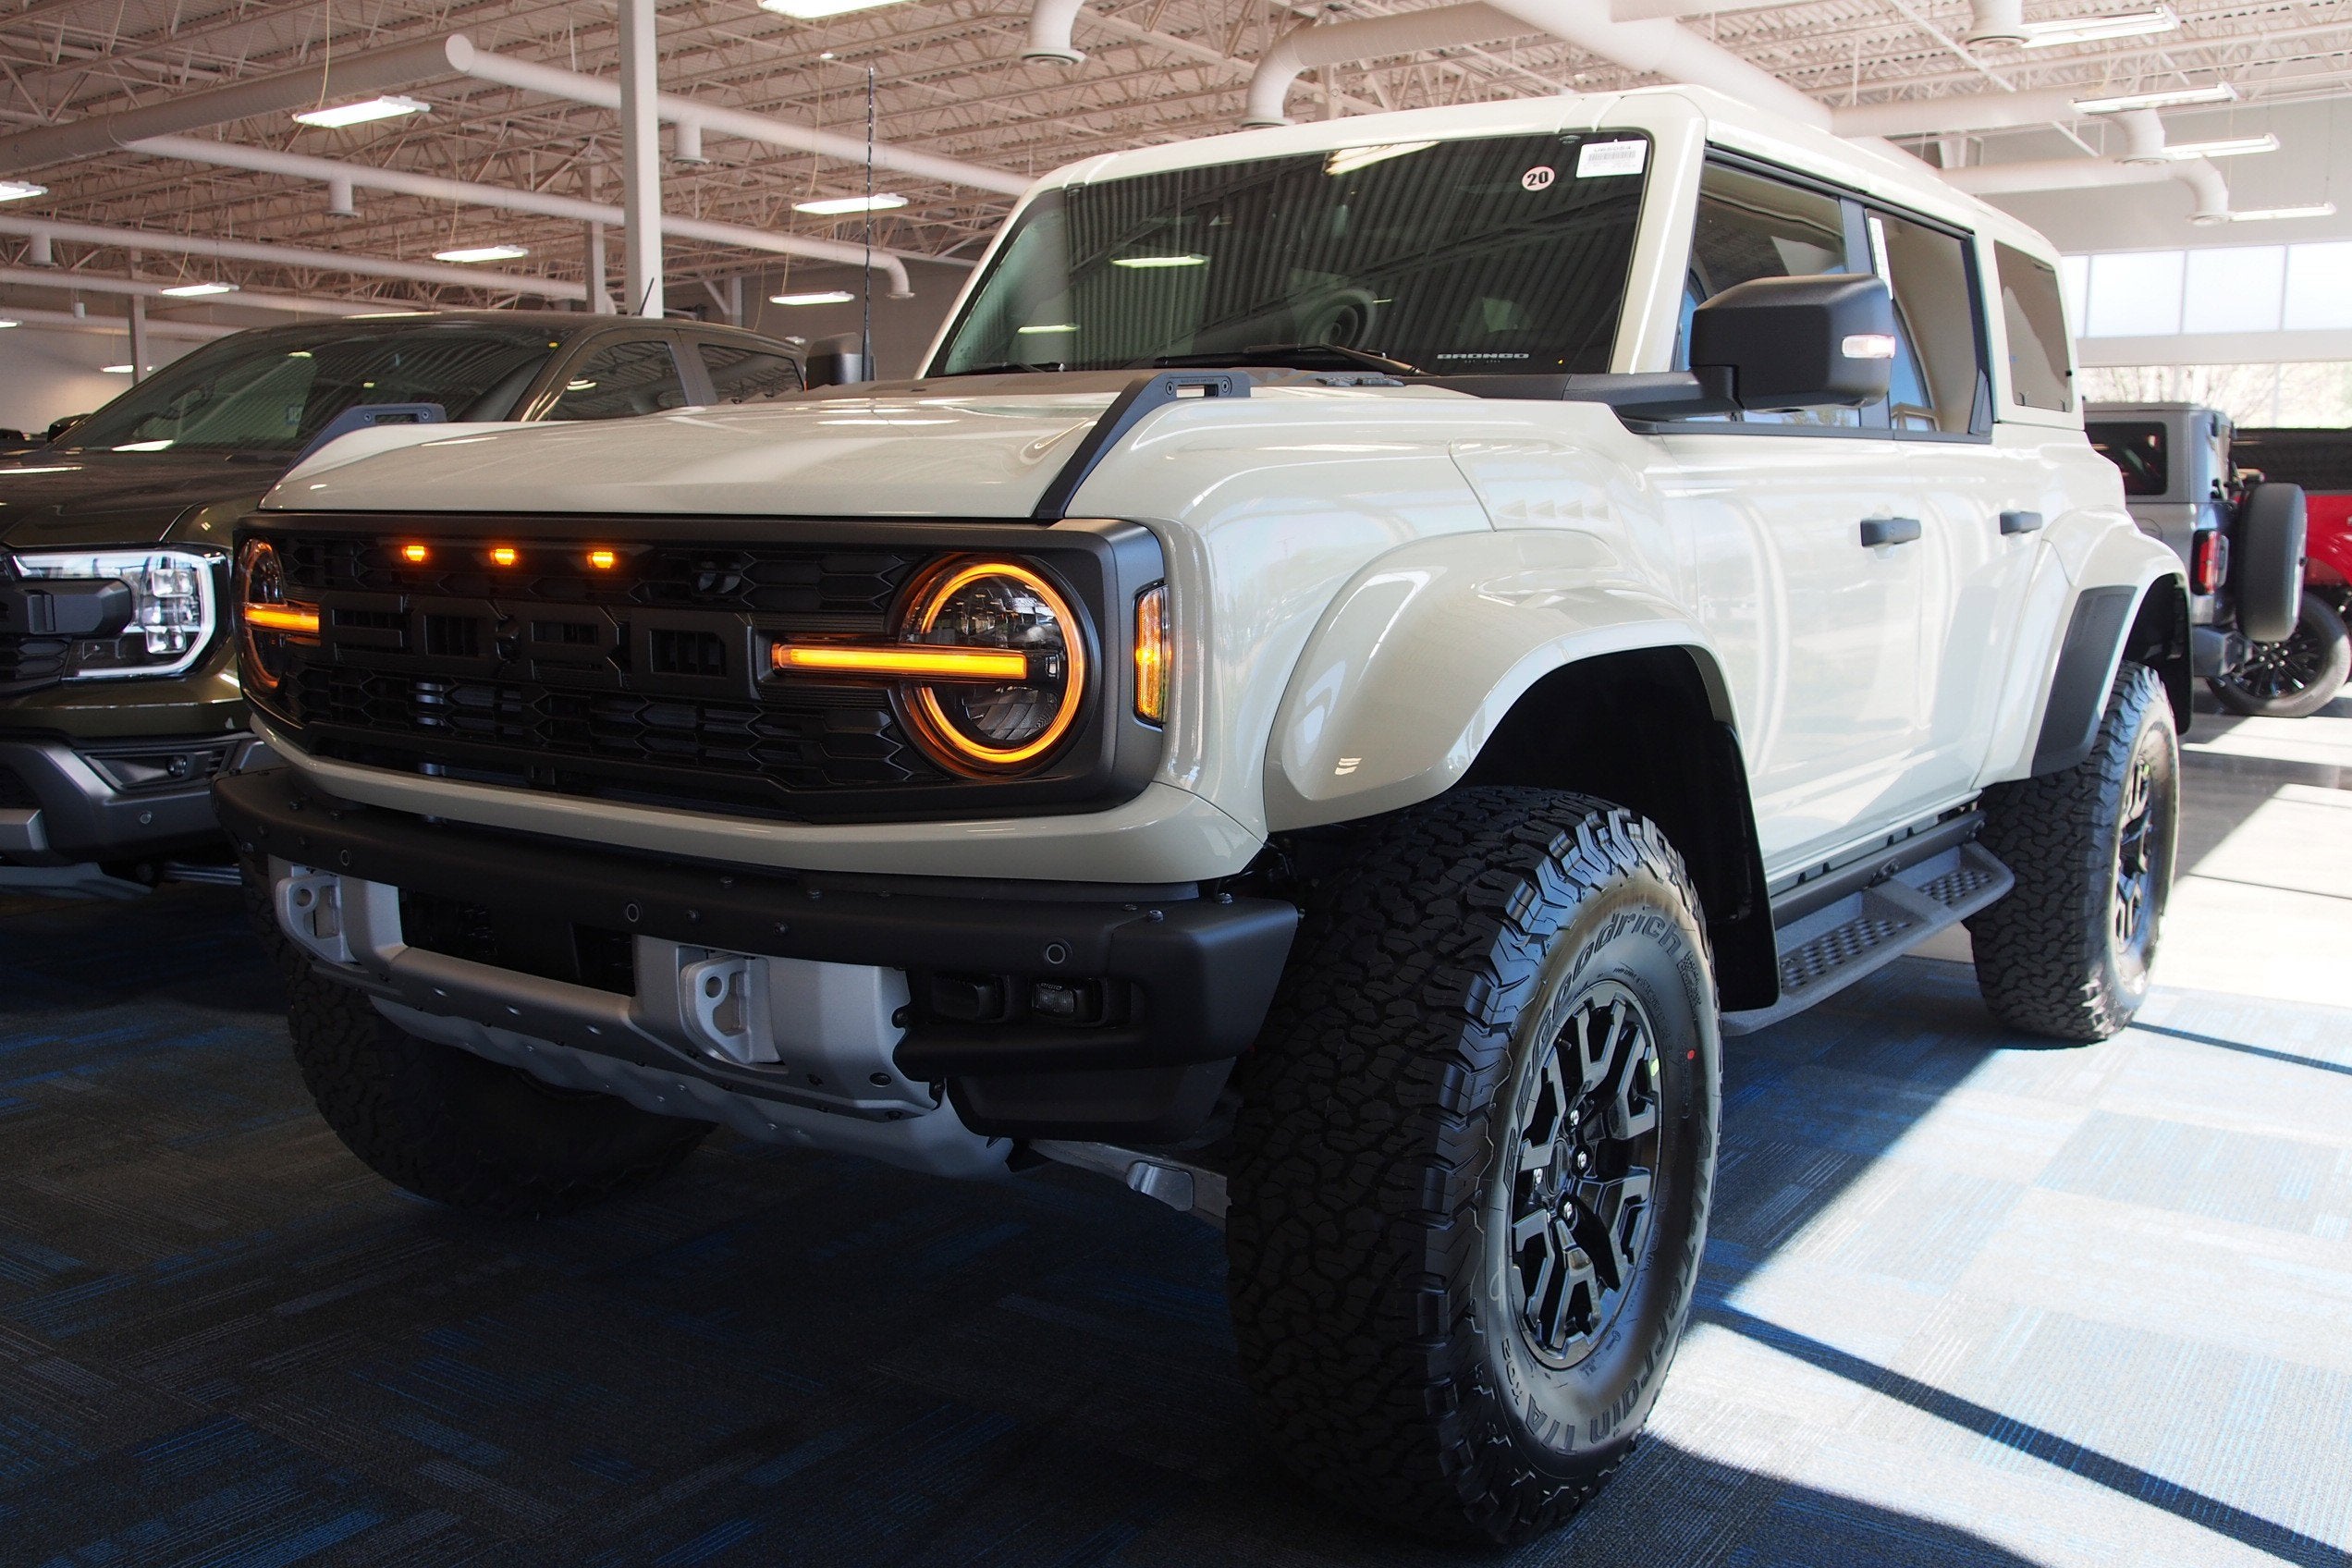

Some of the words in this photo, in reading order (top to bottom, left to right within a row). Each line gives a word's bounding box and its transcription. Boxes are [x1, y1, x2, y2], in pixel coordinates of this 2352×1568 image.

[1527, 171, 1549, 187] 20
[319, 593, 760, 700] FORD
[1590, 1112, 1712, 1444] All-Terrain
[1525, 1393, 1577, 1456] T/A
